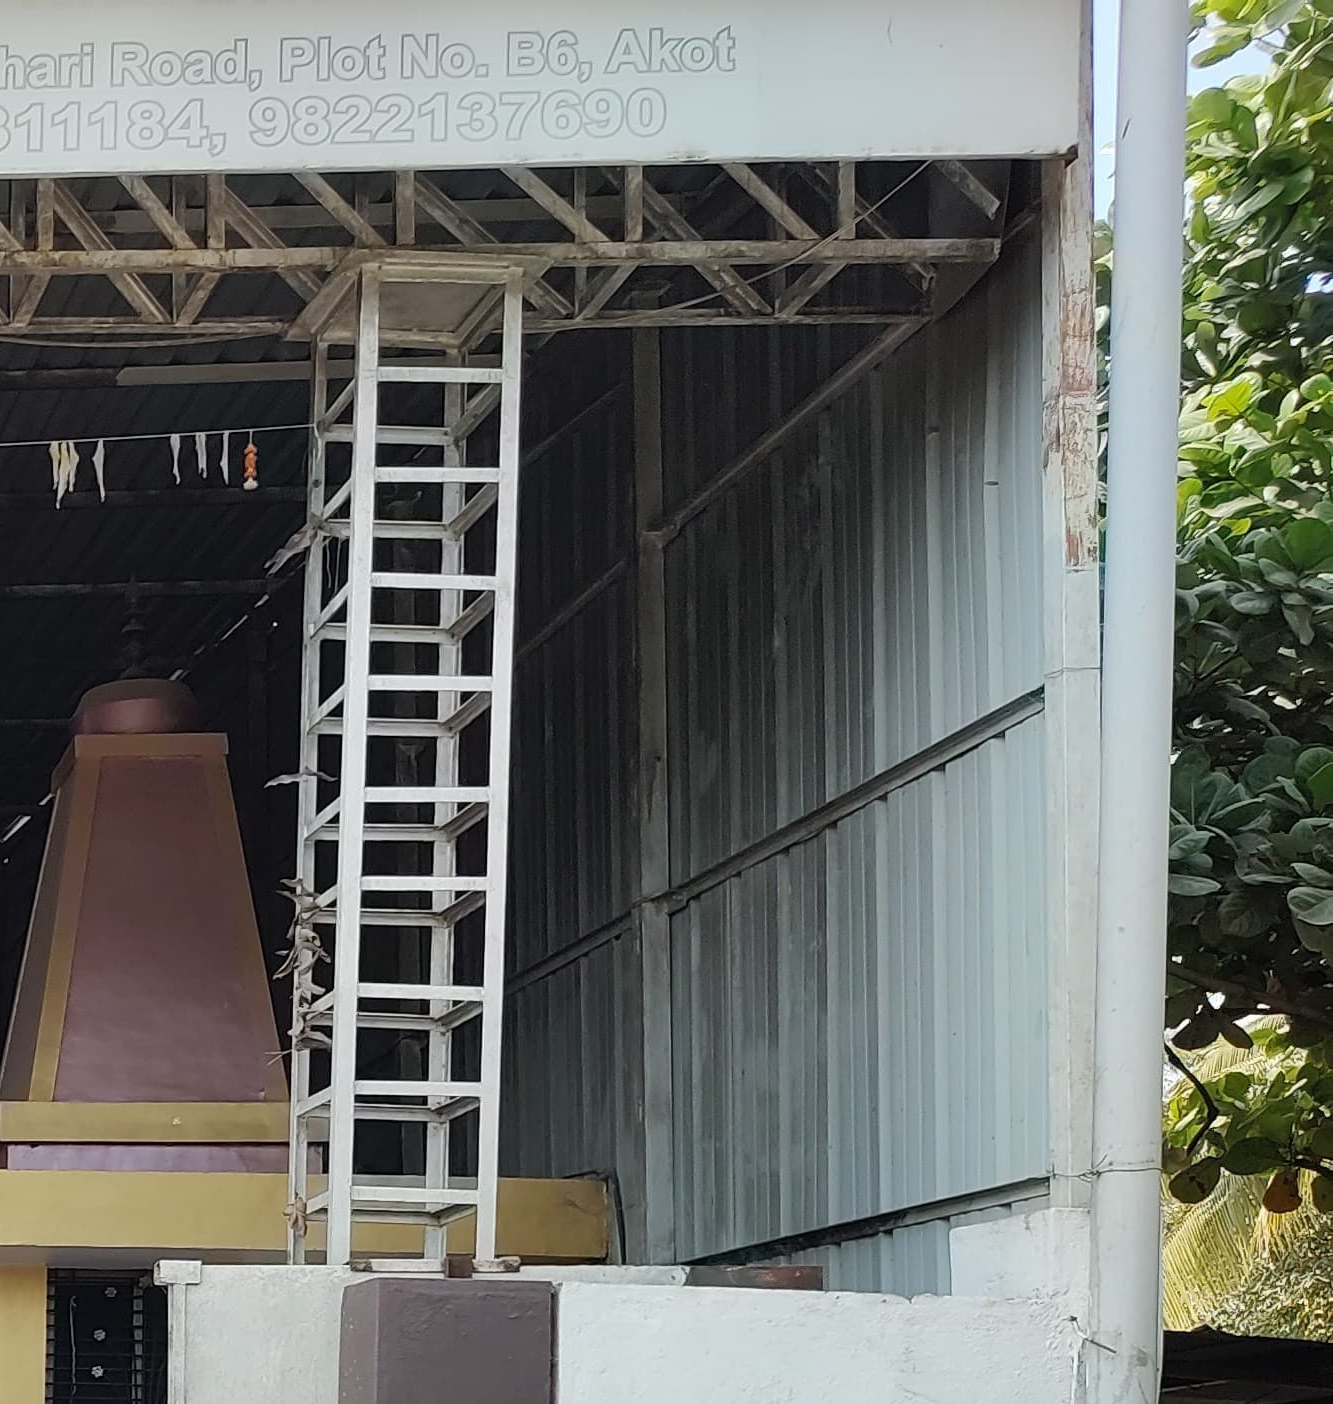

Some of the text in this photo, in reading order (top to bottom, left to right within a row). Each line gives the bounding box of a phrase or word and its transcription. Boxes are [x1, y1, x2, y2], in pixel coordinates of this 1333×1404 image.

[109, 38, 263, 91] Road,
[279, 33, 386, 83] Plot
[400, 33, 490, 80] No.
[506, 30, 593, 81] B6,
[603, 25, 737, 75] Akot
[248, 87, 668, 148] 9822137690
